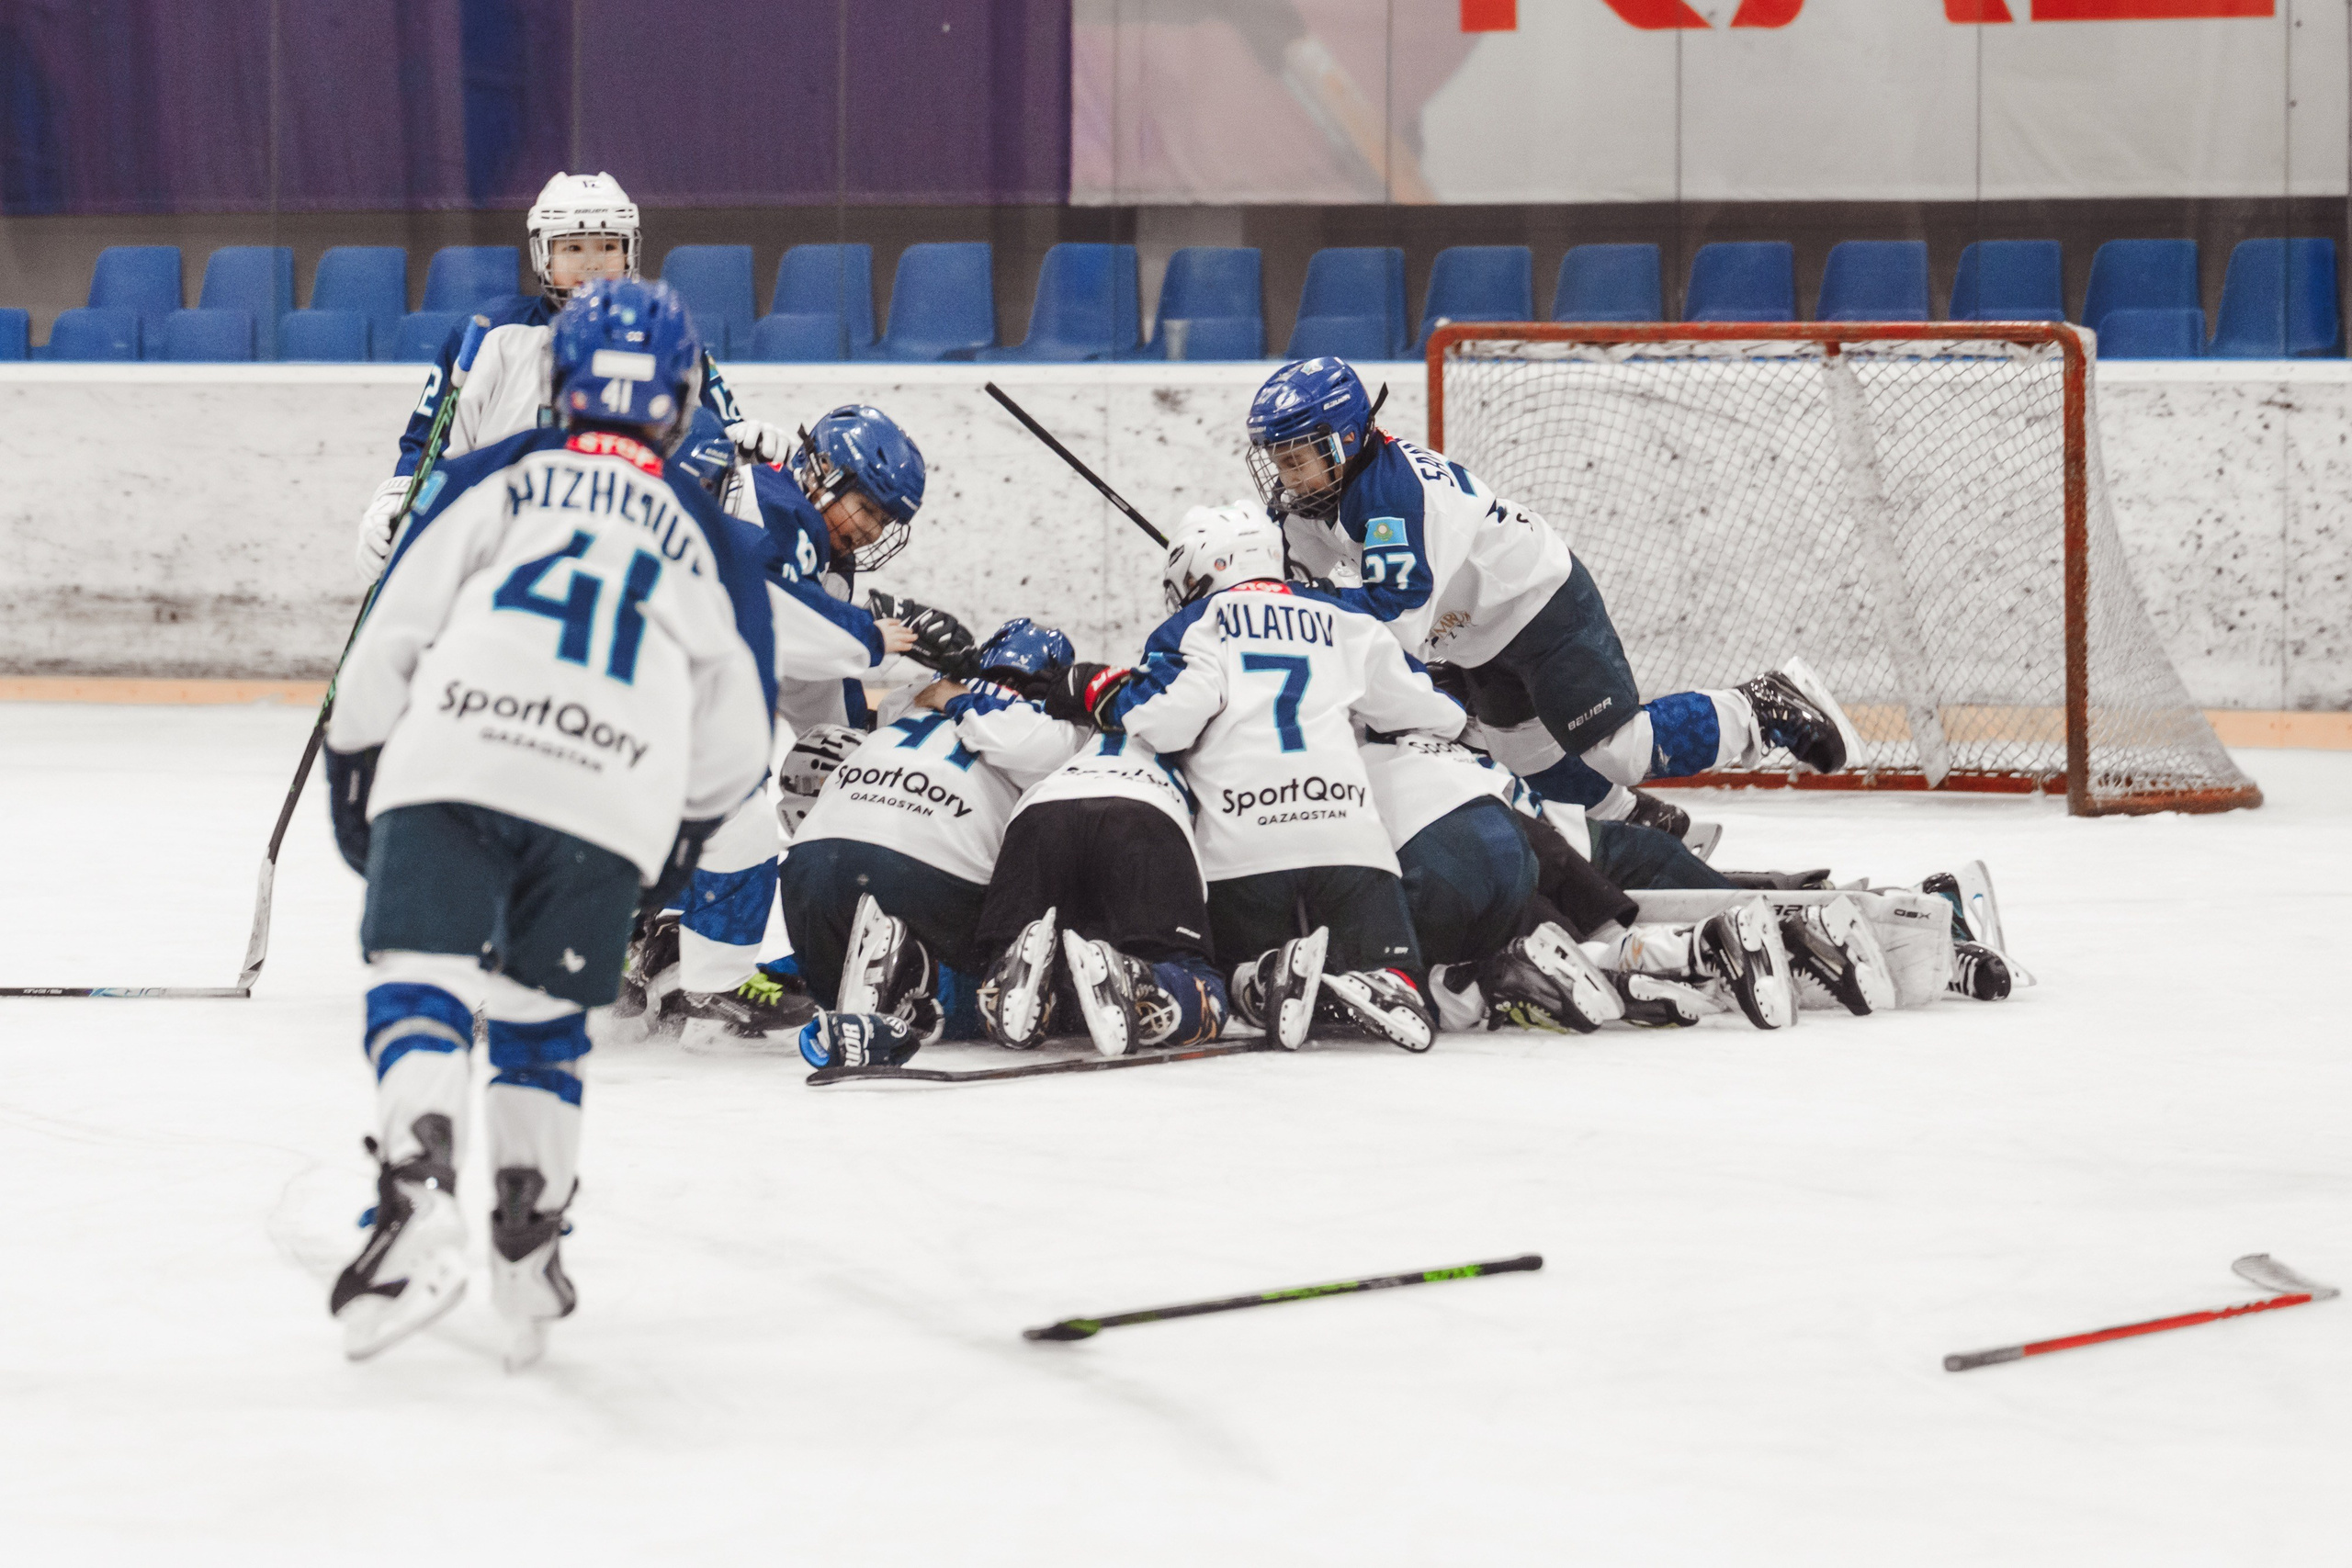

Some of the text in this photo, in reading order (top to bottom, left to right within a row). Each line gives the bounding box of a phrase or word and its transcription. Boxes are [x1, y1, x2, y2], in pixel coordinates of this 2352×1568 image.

[600, 377, 634, 413] 41
[492, 528, 670, 686] 41
[1240, 651, 1313, 754] 7
[1567, 696, 1612, 731] BAUER
[439, 680, 649, 769] SportQory
[835, 764, 973, 818] SportQory
[851, 792, 934, 818] QAZAQSTAN
[1223, 776, 1366, 817] SportQory
[1257, 809, 1348, 827] QAZAQSTAN
